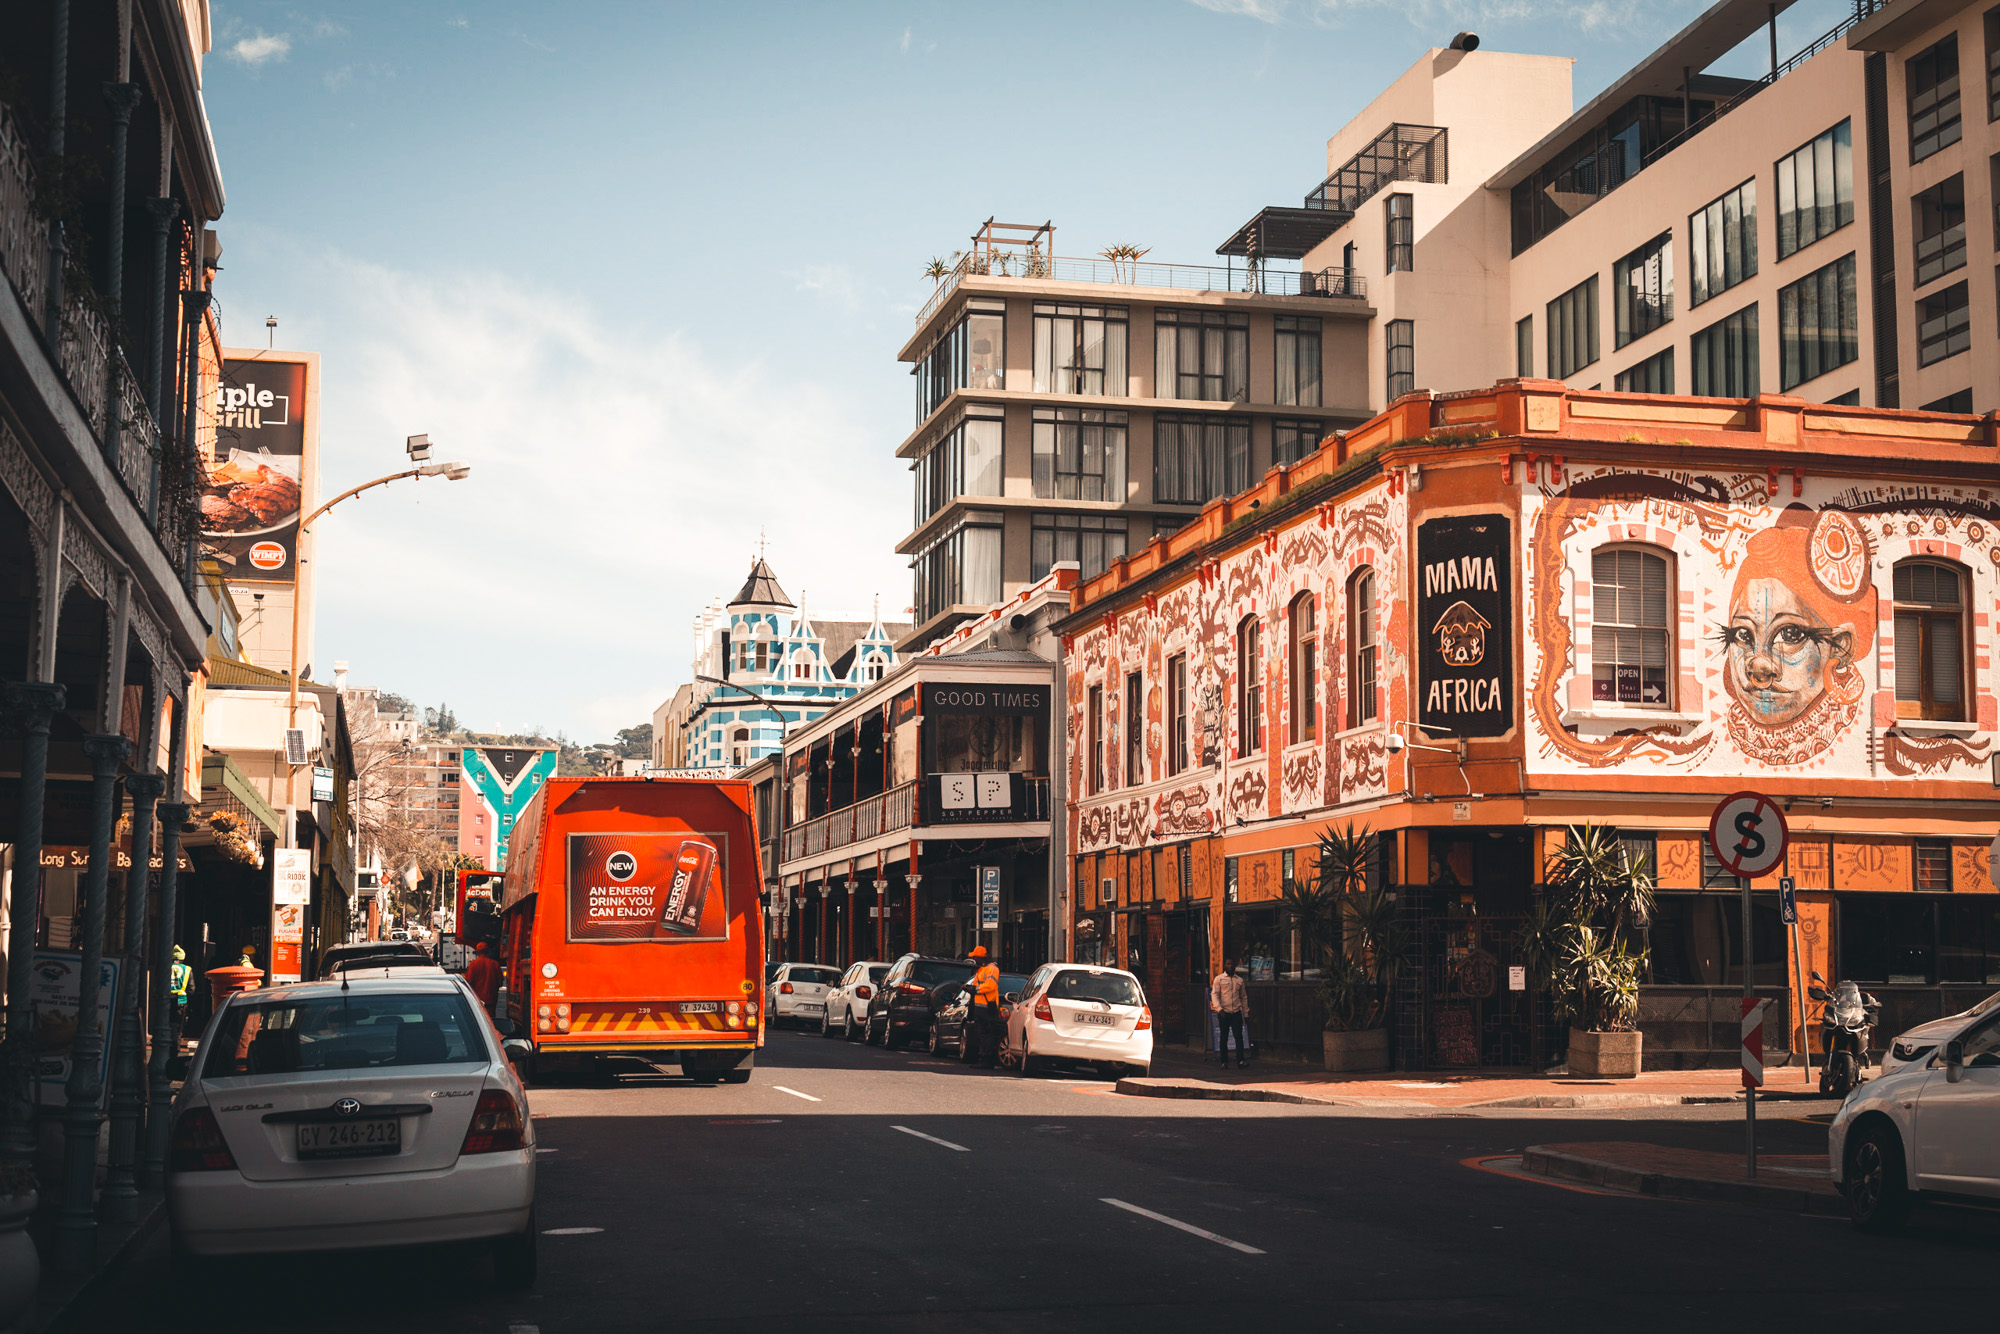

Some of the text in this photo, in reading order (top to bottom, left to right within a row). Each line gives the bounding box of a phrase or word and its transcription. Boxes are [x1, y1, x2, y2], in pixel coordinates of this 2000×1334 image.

[217, 382, 274, 411] iple
[252, 551, 283, 559] WIMPY
[1425, 555, 1498, 598] MAMA
[1618, 669, 1639, 678] OPEN
[934, 691, 1040, 708] GOOD TIMES
[1427, 677, 1502, 714] AFRICA
[952, 781, 964, 802] S
[1733, 811, 1766, 858] S
[40, 850, 65, 867] Long
[609, 862, 634, 871] NEW
[987, 870, 996, 881] P
[589, 886, 656, 896] AN ENERGY
[664, 869, 686, 921] ENERGY
[1782, 880, 1791, 899] P
[589, 897, 653, 906] DRINK YOU
[589, 907, 656, 917] CAN ENJOY
[742, 983, 753, 991] 80
[679, 1002, 717, 1013] CY 37434
[301, 1127, 320, 1146] CY
